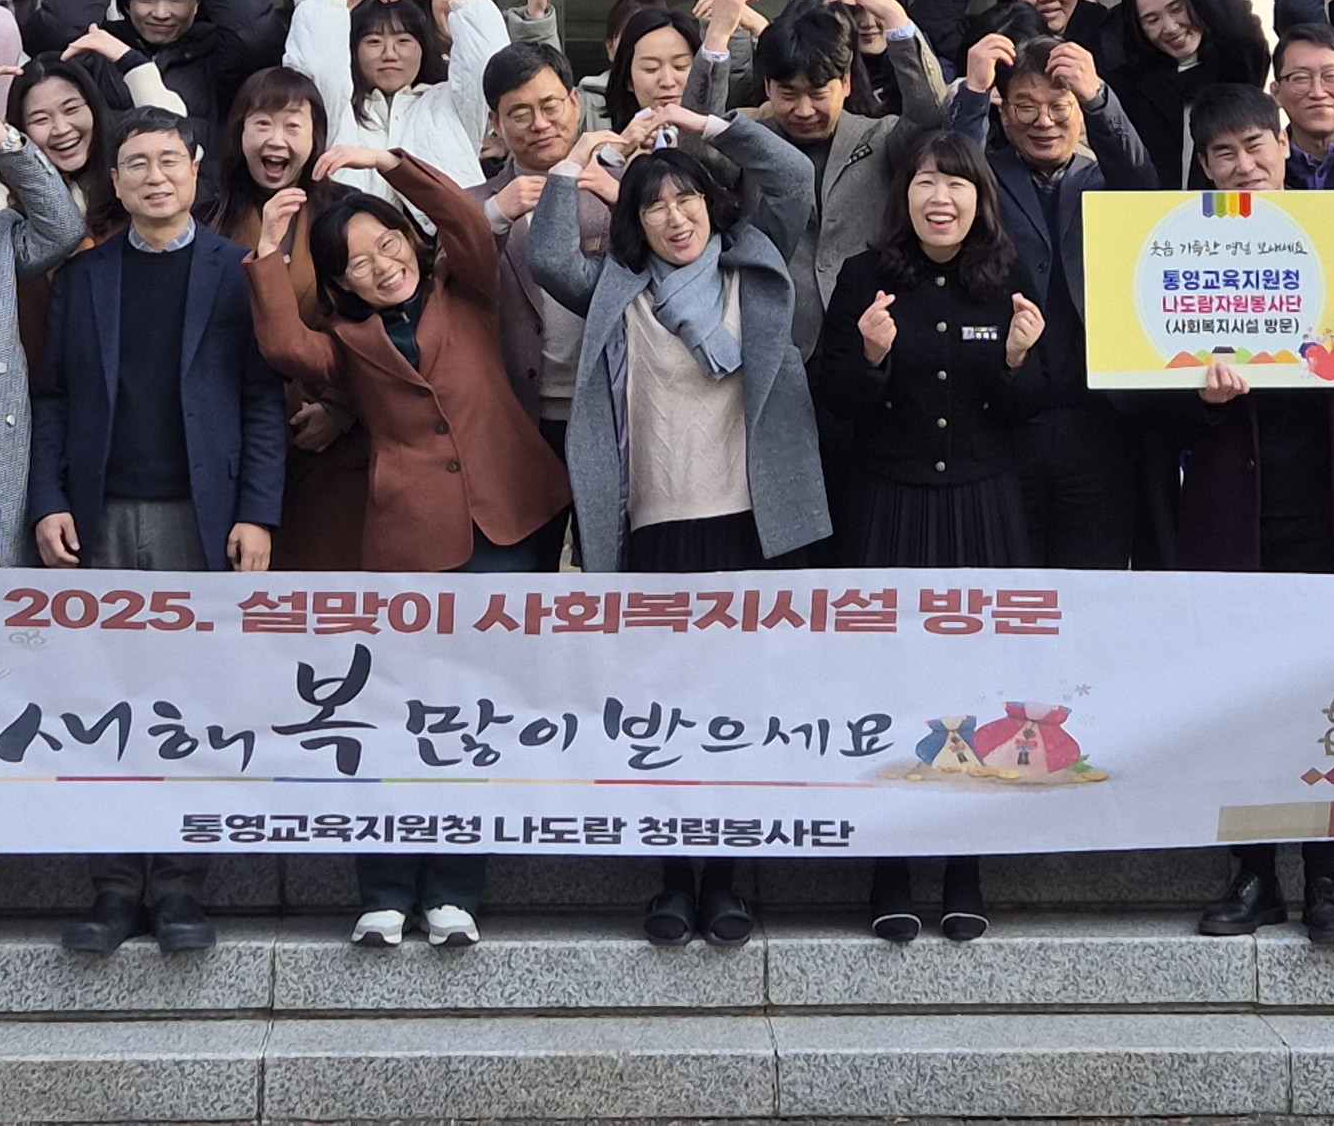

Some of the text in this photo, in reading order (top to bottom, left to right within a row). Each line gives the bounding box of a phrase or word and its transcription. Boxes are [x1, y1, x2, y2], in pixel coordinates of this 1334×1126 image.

[1162, 269, 1301, 291] 통영교육지원청
[1162, 294, 1302, 314] 나도람자원봉사단
[1165, 318, 1300, 335] (사회복지시설 방문)
[3, 587, 1061, 636] 2025. 설맞이 사회복지시설 방문
[270, 643, 379, 776] 복
[405, 698, 578, 767] 많이
[603, 697, 895, 771] 받으세요
[179, 811, 855, 849] 통영교육지원청 나도람 청렴봉사단
